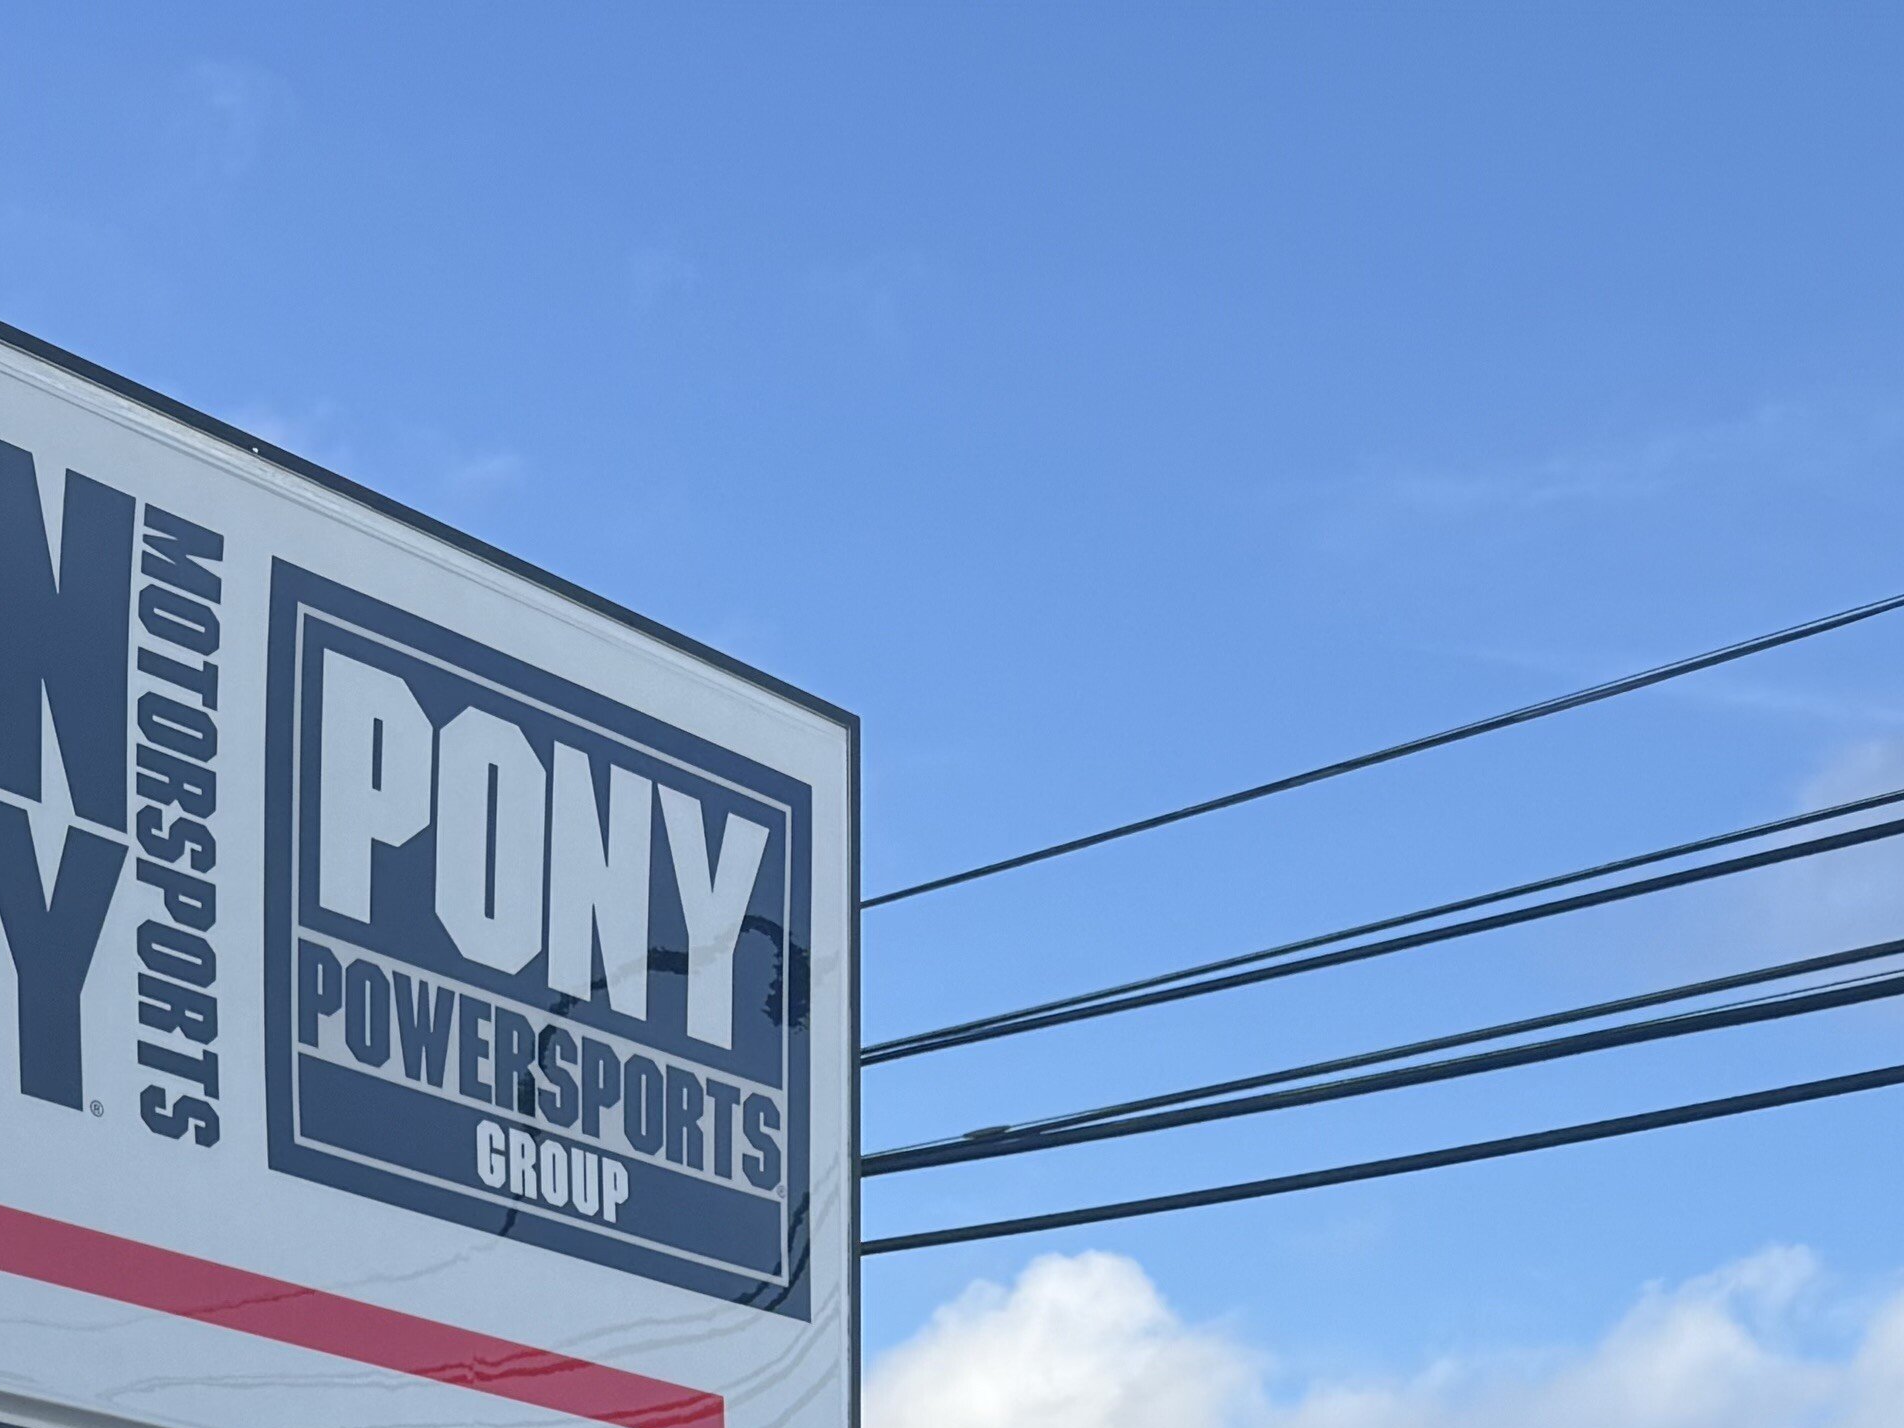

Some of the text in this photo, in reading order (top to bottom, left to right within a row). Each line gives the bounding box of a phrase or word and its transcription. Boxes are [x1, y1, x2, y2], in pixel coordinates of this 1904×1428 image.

[138, 504, 225, 1148] MOTORSPORTS
[320, 659, 769, 1055] PONY
[298, 940, 782, 1190] POWERSPORTS
[476, 1119, 630, 1224] GROUP
